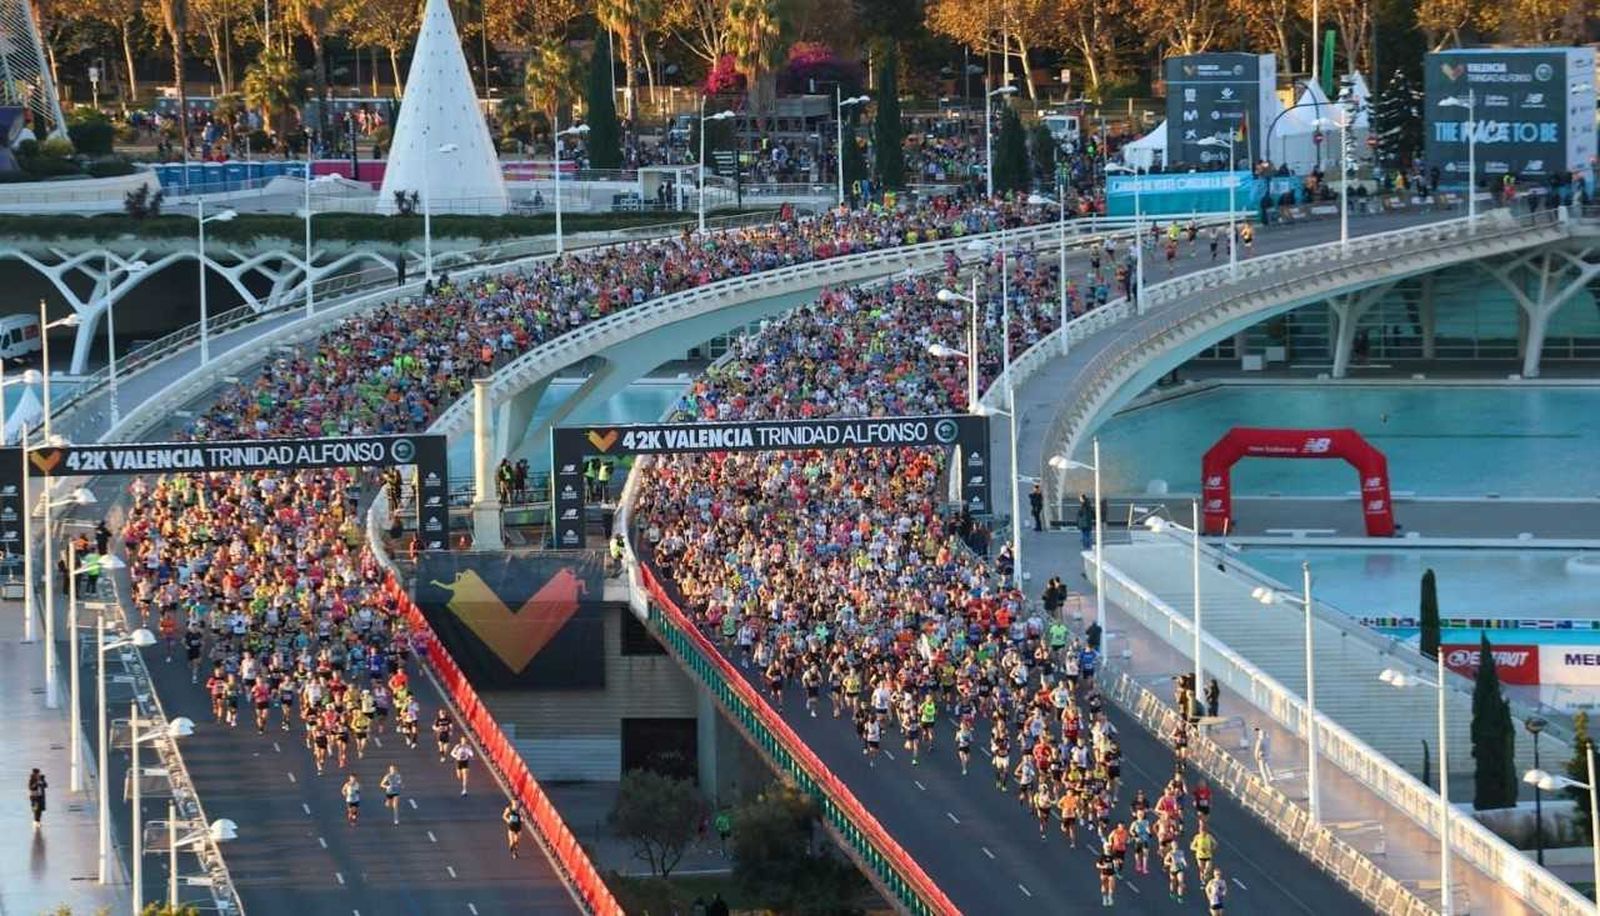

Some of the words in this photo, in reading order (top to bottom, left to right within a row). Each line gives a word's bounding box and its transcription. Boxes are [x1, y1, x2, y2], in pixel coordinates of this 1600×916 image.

[1434, 122, 1458, 142] THE
[1460, 120, 1510, 144] RACE
[1512, 123, 1538, 143] TO
[1540, 123, 1558, 142] BE
[622, 430, 662, 450] 42K
[663, 428, 754, 448] VALENCIA
[756, 425, 839, 446] TRINIDAD
[842, 422, 928, 443] ALFONSO
[66, 450, 108, 471] 42K
[110, 448, 204, 470] VALENCIA
[206, 446, 294, 467] TRINIDAD
[295, 443, 385, 464] ALFONSO
